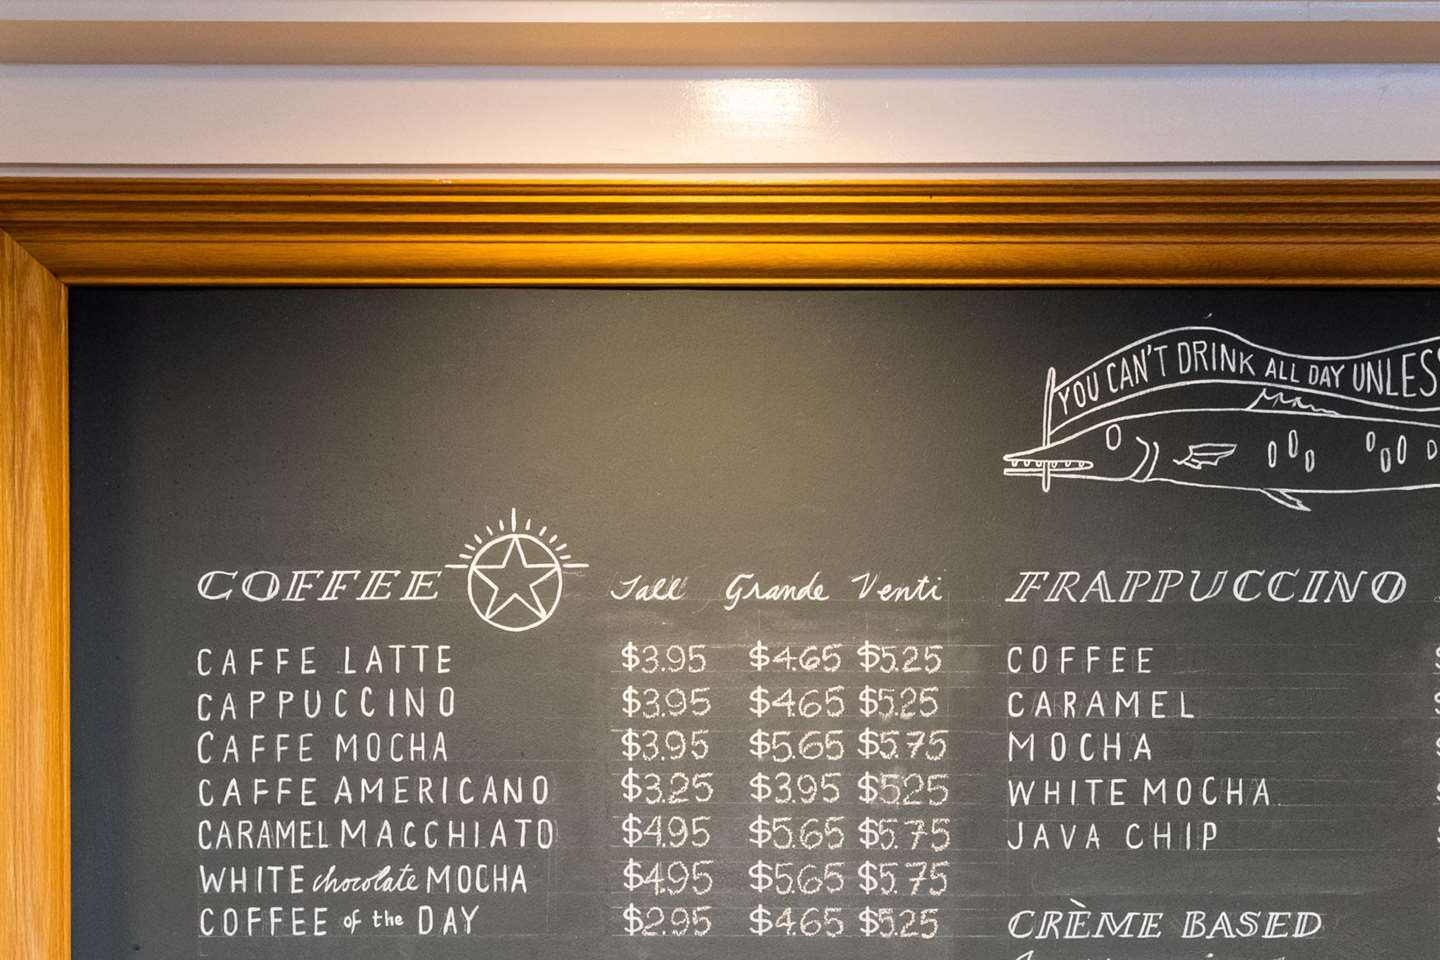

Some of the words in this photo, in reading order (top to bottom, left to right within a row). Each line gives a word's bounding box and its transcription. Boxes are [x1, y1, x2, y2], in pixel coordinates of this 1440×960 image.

[1054, 369, 1102, 419] YOU
[1104, 341, 1171, 396] CAN'T
[1178, 337, 1259, 375] DRINK
[1261, 358, 1299, 386] ALL
[1309, 365, 1345, 388] DAY
[198, 570, 442, 602] COFFEE
[611, 575, 682, 601] Tall
[724, 572, 829, 610] Grande
[852, 573, 942, 601] Venti
[1005, 569, 1406, 603] FRAPPUCCINO
[197, 647, 316, 676] CAFFE
[345, 645, 450, 674] LATTE
[621, 641, 706, 673] $3.95
[749, 640, 843, 672] $4.65
[857, 640, 943, 674] $5.25
[1008, 645, 1153, 673] COFFEE
[198, 687, 454, 721] CAPPUCCINO
[1008, 691, 1194, 718] CARAMEL
[197, 731, 313, 764] CAFFE
[336, 732, 447, 762] MOCHA
[1009, 732, 1151, 761] MOCHA
[199, 778, 316, 806] CAFFE
[334, 776, 548, 804] AMERICANO
[1008, 779, 1126, 806] WHITE
[1144, 777, 1269, 805] MOCHA
[198, 820, 328, 850] CARAMEL
[341, 819, 553, 849] MACCHIATO
[1008, 822, 1099, 850] JAVA
[1126, 822, 1217, 850] CHIP
[200, 865, 304, 893] WHITE
[313, 864, 418, 892] chocolate
[427, 864, 527, 893] MOCHA
[200, 907, 327, 936] COFFEE
[343, 909, 361, 933] of
[373, 910, 404, 927] the
[419, 905, 479, 935] DAY
[1008, 898, 1163, 939] CRÈME
[1182, 911, 1321, 939] BASED
